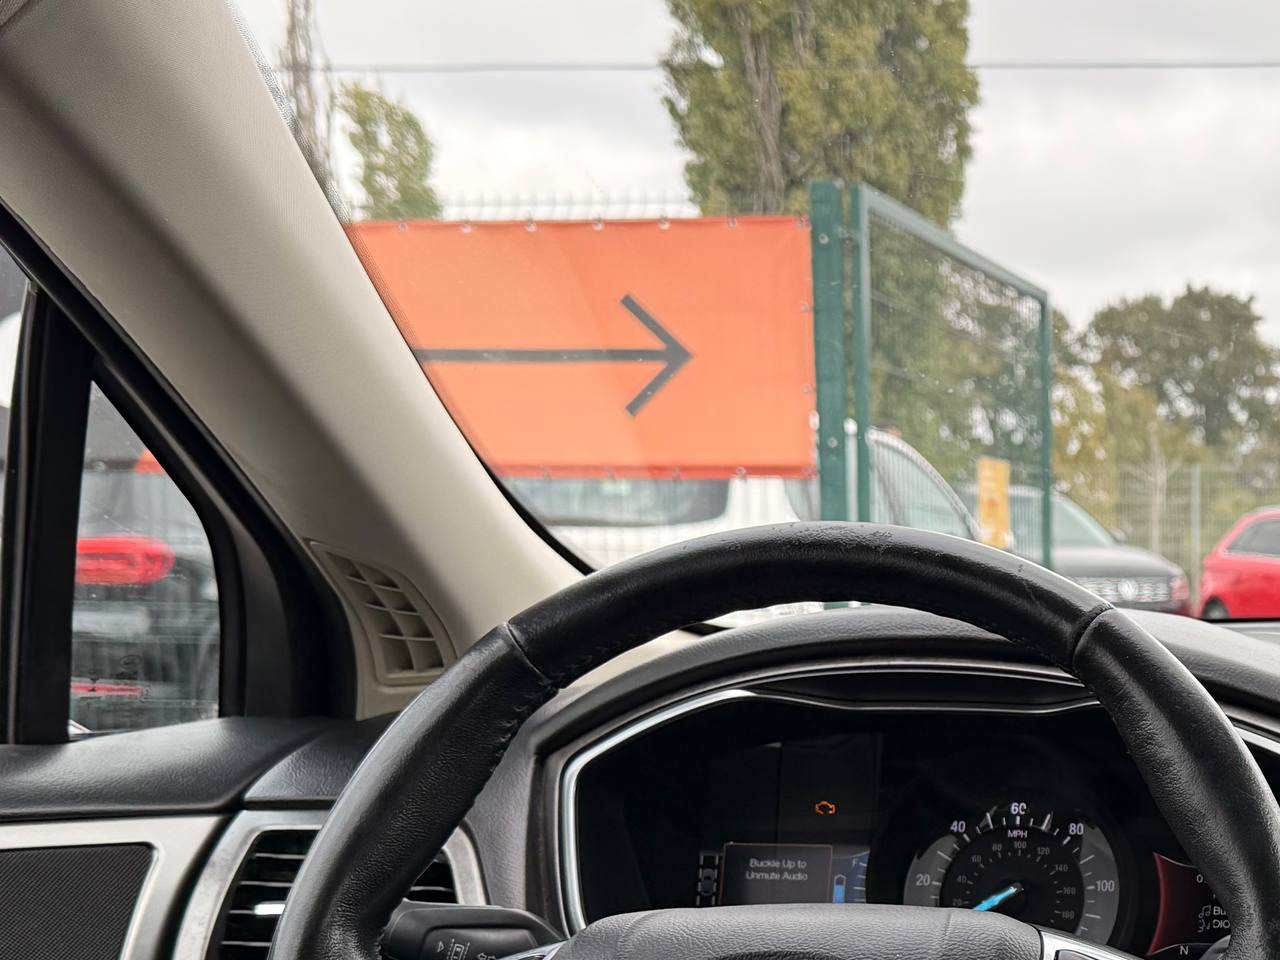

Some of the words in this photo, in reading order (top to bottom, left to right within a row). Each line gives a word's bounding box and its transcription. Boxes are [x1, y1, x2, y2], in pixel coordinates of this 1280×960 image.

[1010, 802, 1026, 815] 60
[951, 820, 966, 833] 40
[1068, 823, 1084, 835] 80
[1007, 830, 1028, 838] MPH
[749, 858, 781, 868] Buckle
[782, 859, 796, 870] Up
[797, 859, 807, 868] to
[746, 871, 781, 880] Unmute
[782, 871, 808, 881] Audio
[916, 874, 931, 886] 20
[1096, 880, 1115, 892] 100
[1180, 945, 1189, 955] N
